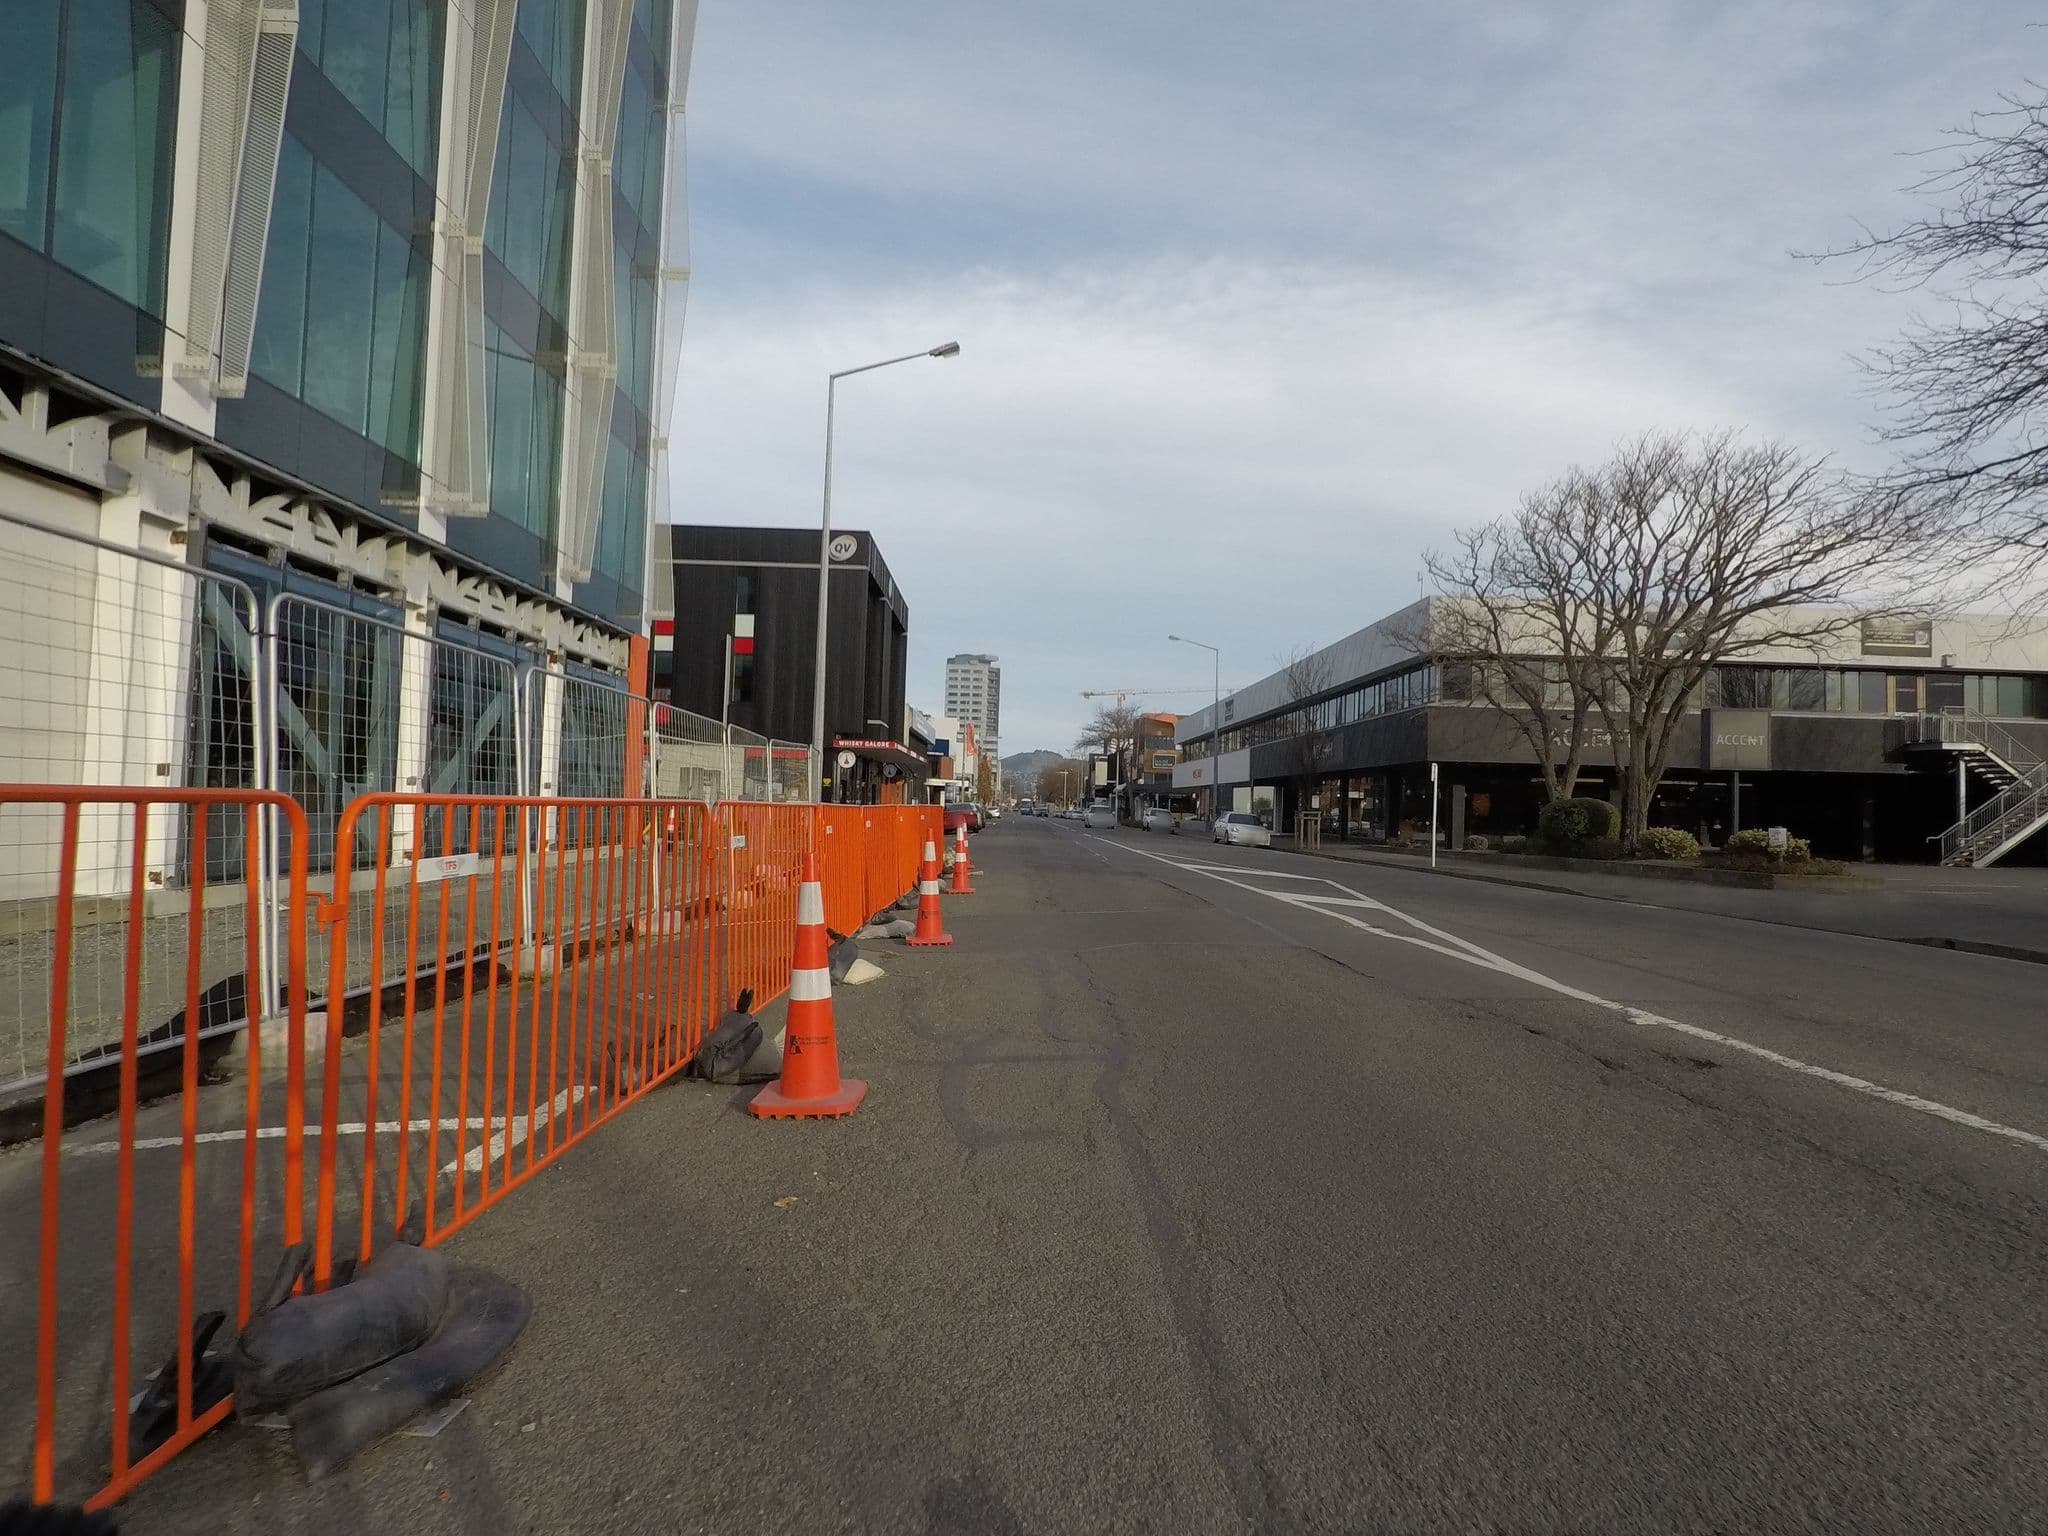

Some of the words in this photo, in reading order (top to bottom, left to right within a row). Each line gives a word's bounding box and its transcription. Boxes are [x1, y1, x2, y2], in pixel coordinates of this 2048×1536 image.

[834, 542, 851, 554] QV
[838, 740, 864, 748] WHISKY
[864, 740, 890, 749] GALORE
[1715, 734, 1766, 746] ACCENT
